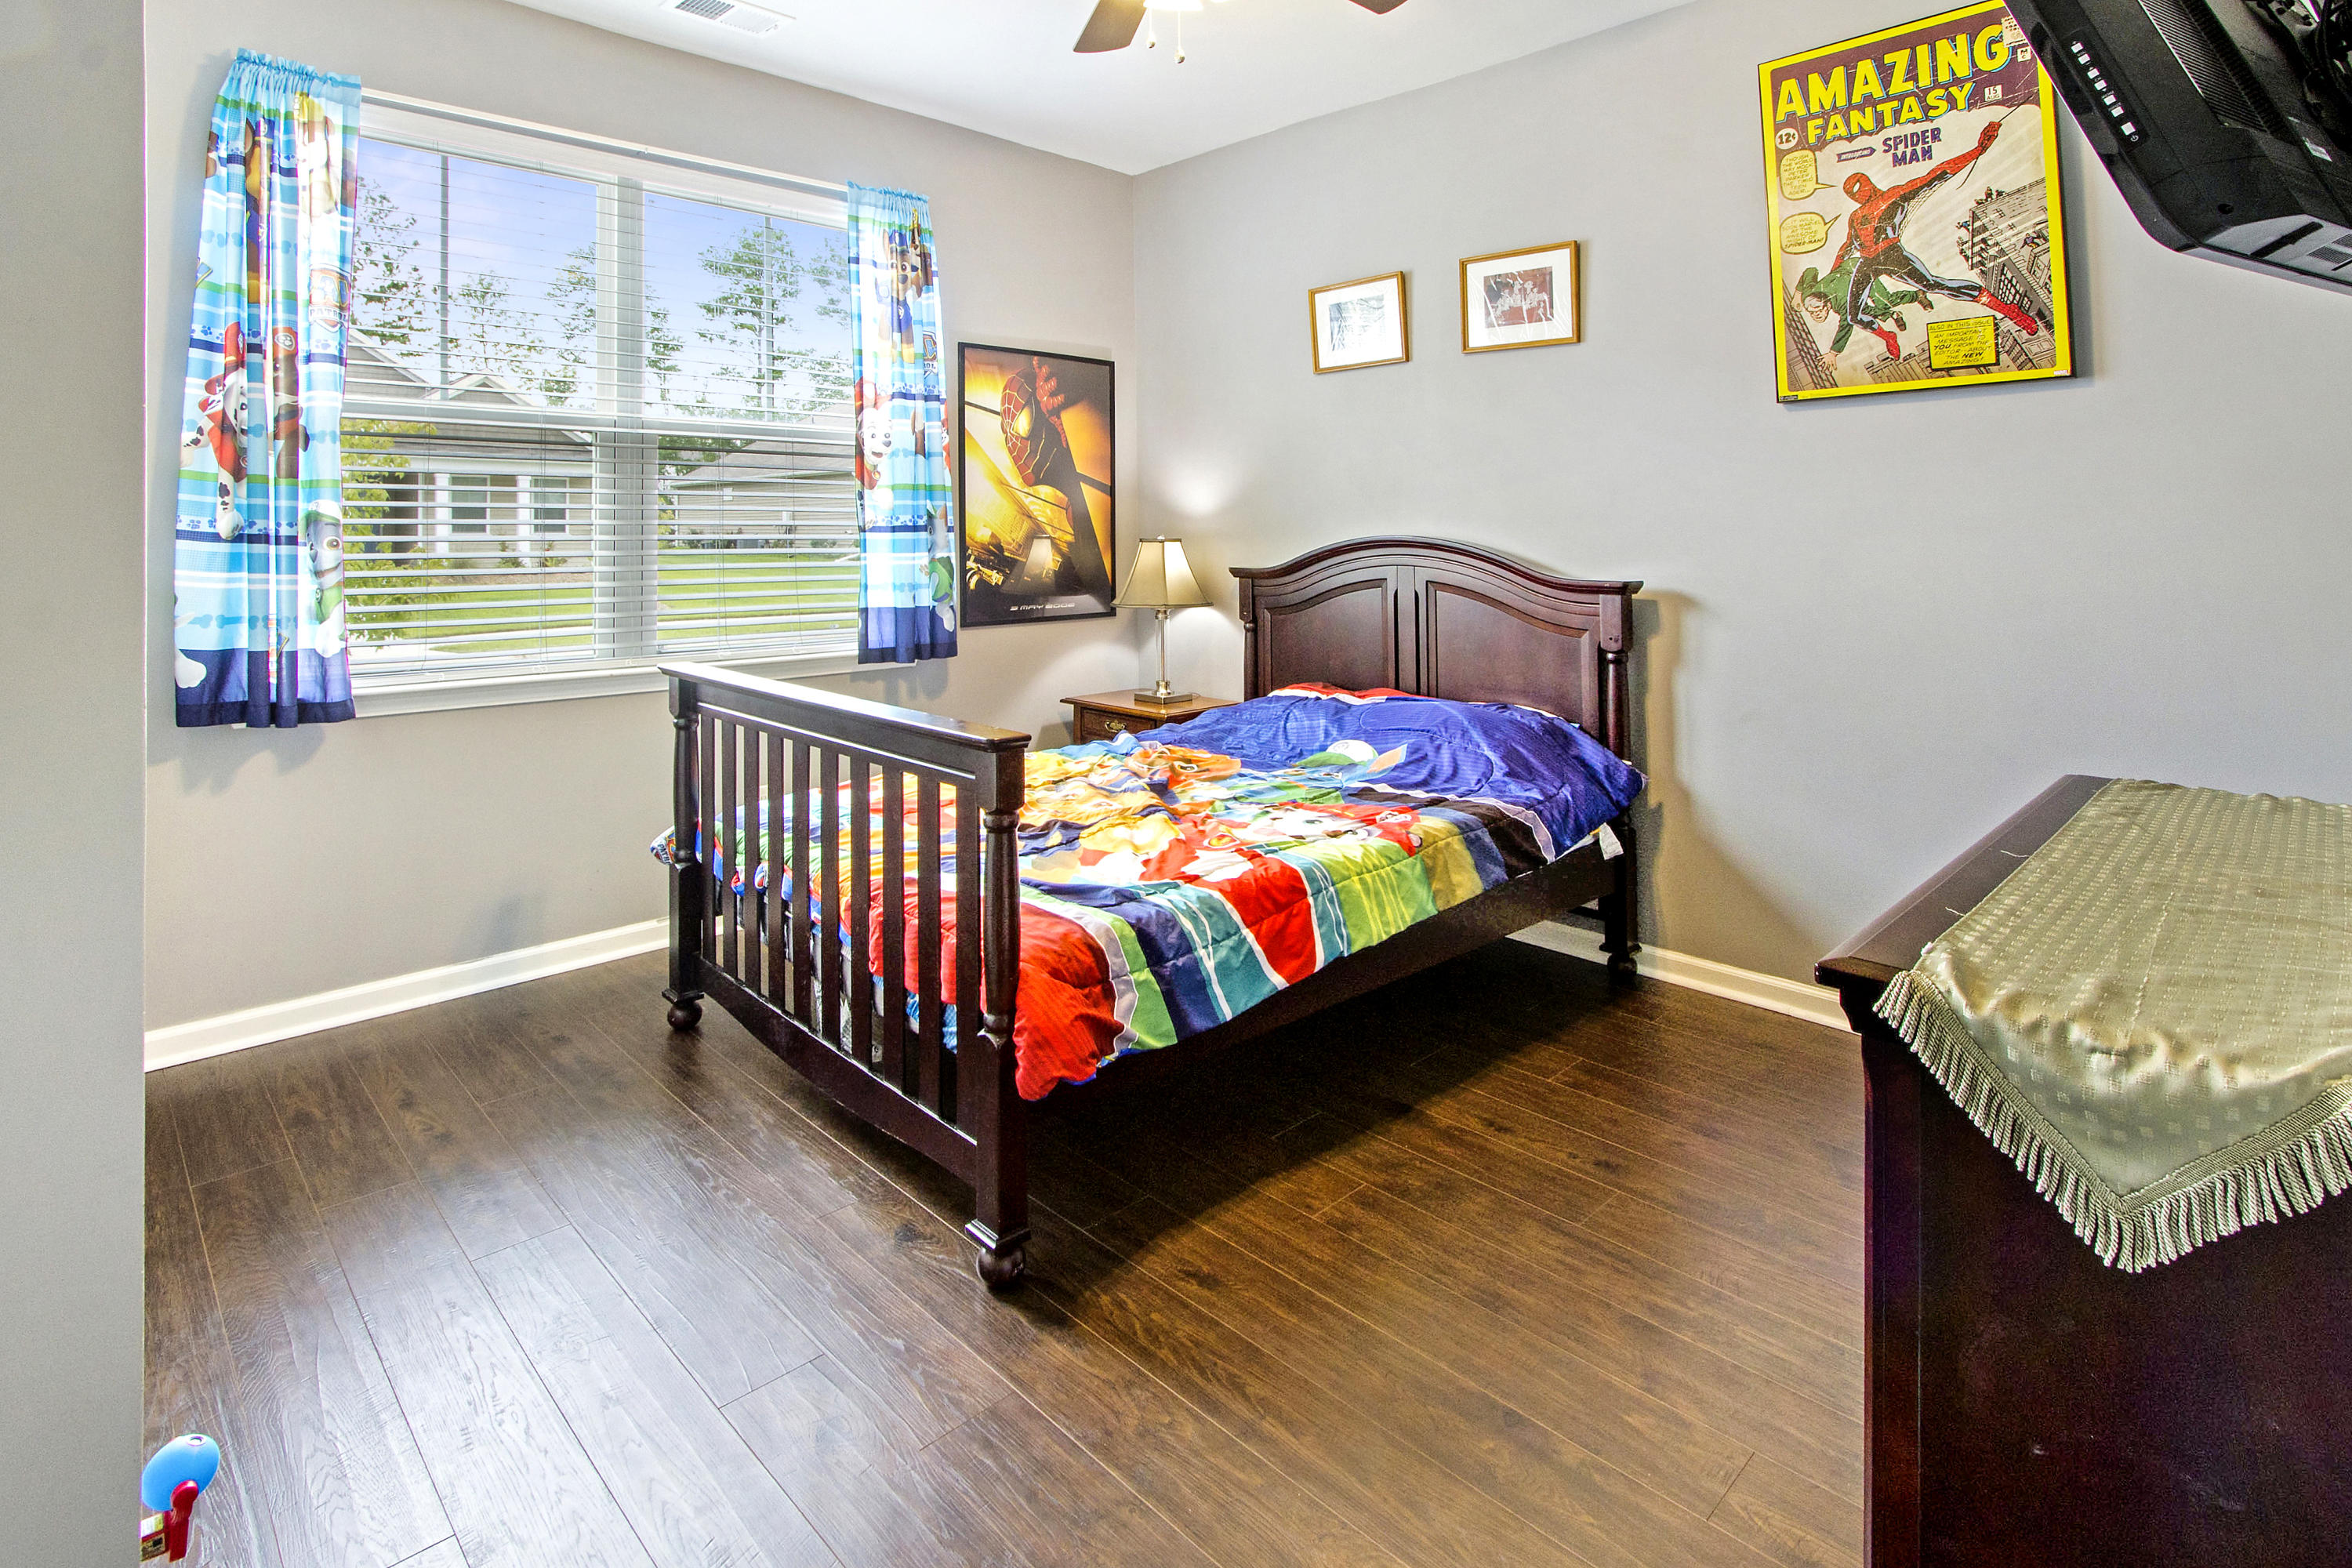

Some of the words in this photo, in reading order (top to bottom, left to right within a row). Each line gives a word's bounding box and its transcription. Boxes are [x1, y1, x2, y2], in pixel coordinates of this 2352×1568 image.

[1776, 24, 2012, 123] AMAZING
[1988, 86, 1997, 96] 15
[1807, 82, 1976, 145] FANTASY
[1882, 127, 1941, 153] SPIDER
[1893, 145, 1933, 168] MAN
